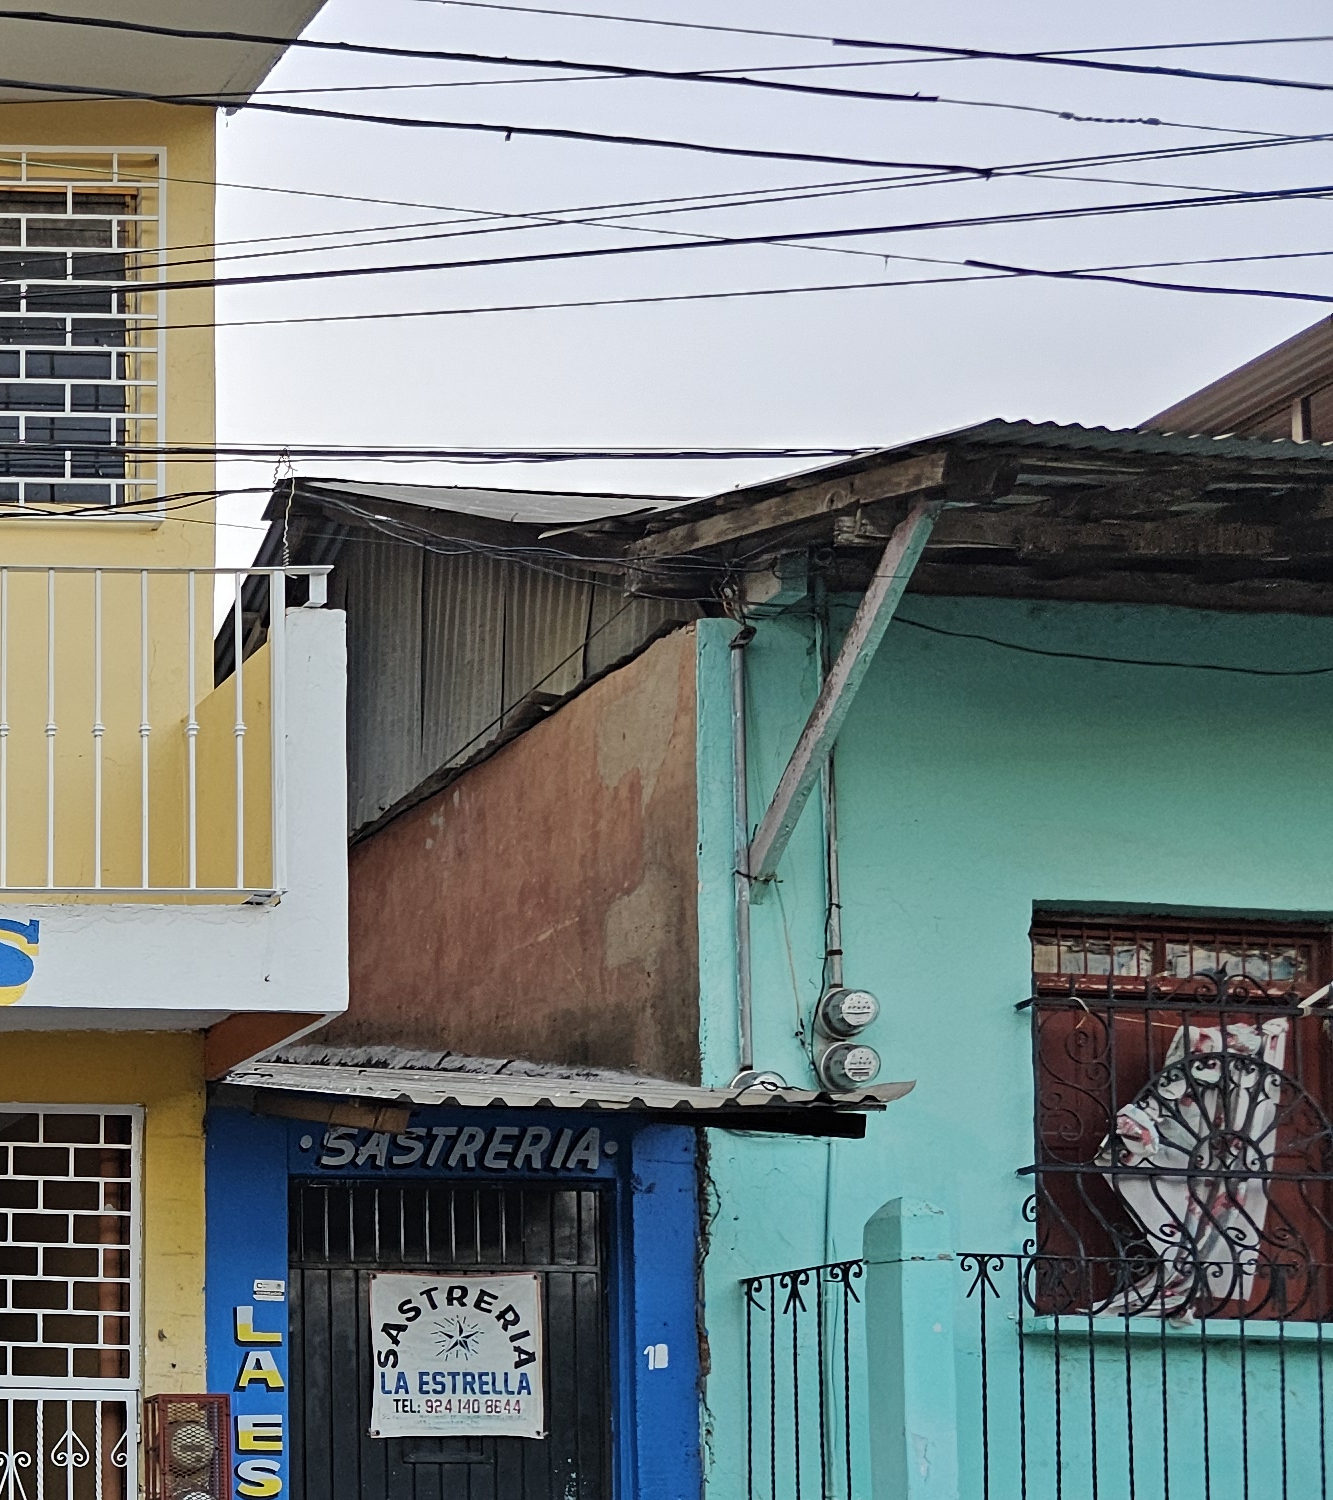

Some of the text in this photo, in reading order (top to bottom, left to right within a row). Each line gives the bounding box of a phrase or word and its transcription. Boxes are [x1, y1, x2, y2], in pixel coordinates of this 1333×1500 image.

[319, 1126, 601, 1170] SASTRERIA
[234, 1305, 283, 1393] LA
[377, 1285, 537, 1370] SASTRERIA
[380, 1371, 532, 1396] LA ESTRELLA
[393, 1398, 421, 1414] TEL:
[425, 1398, 453, 1414] 924
[457, 1398, 481, 1414] 140
